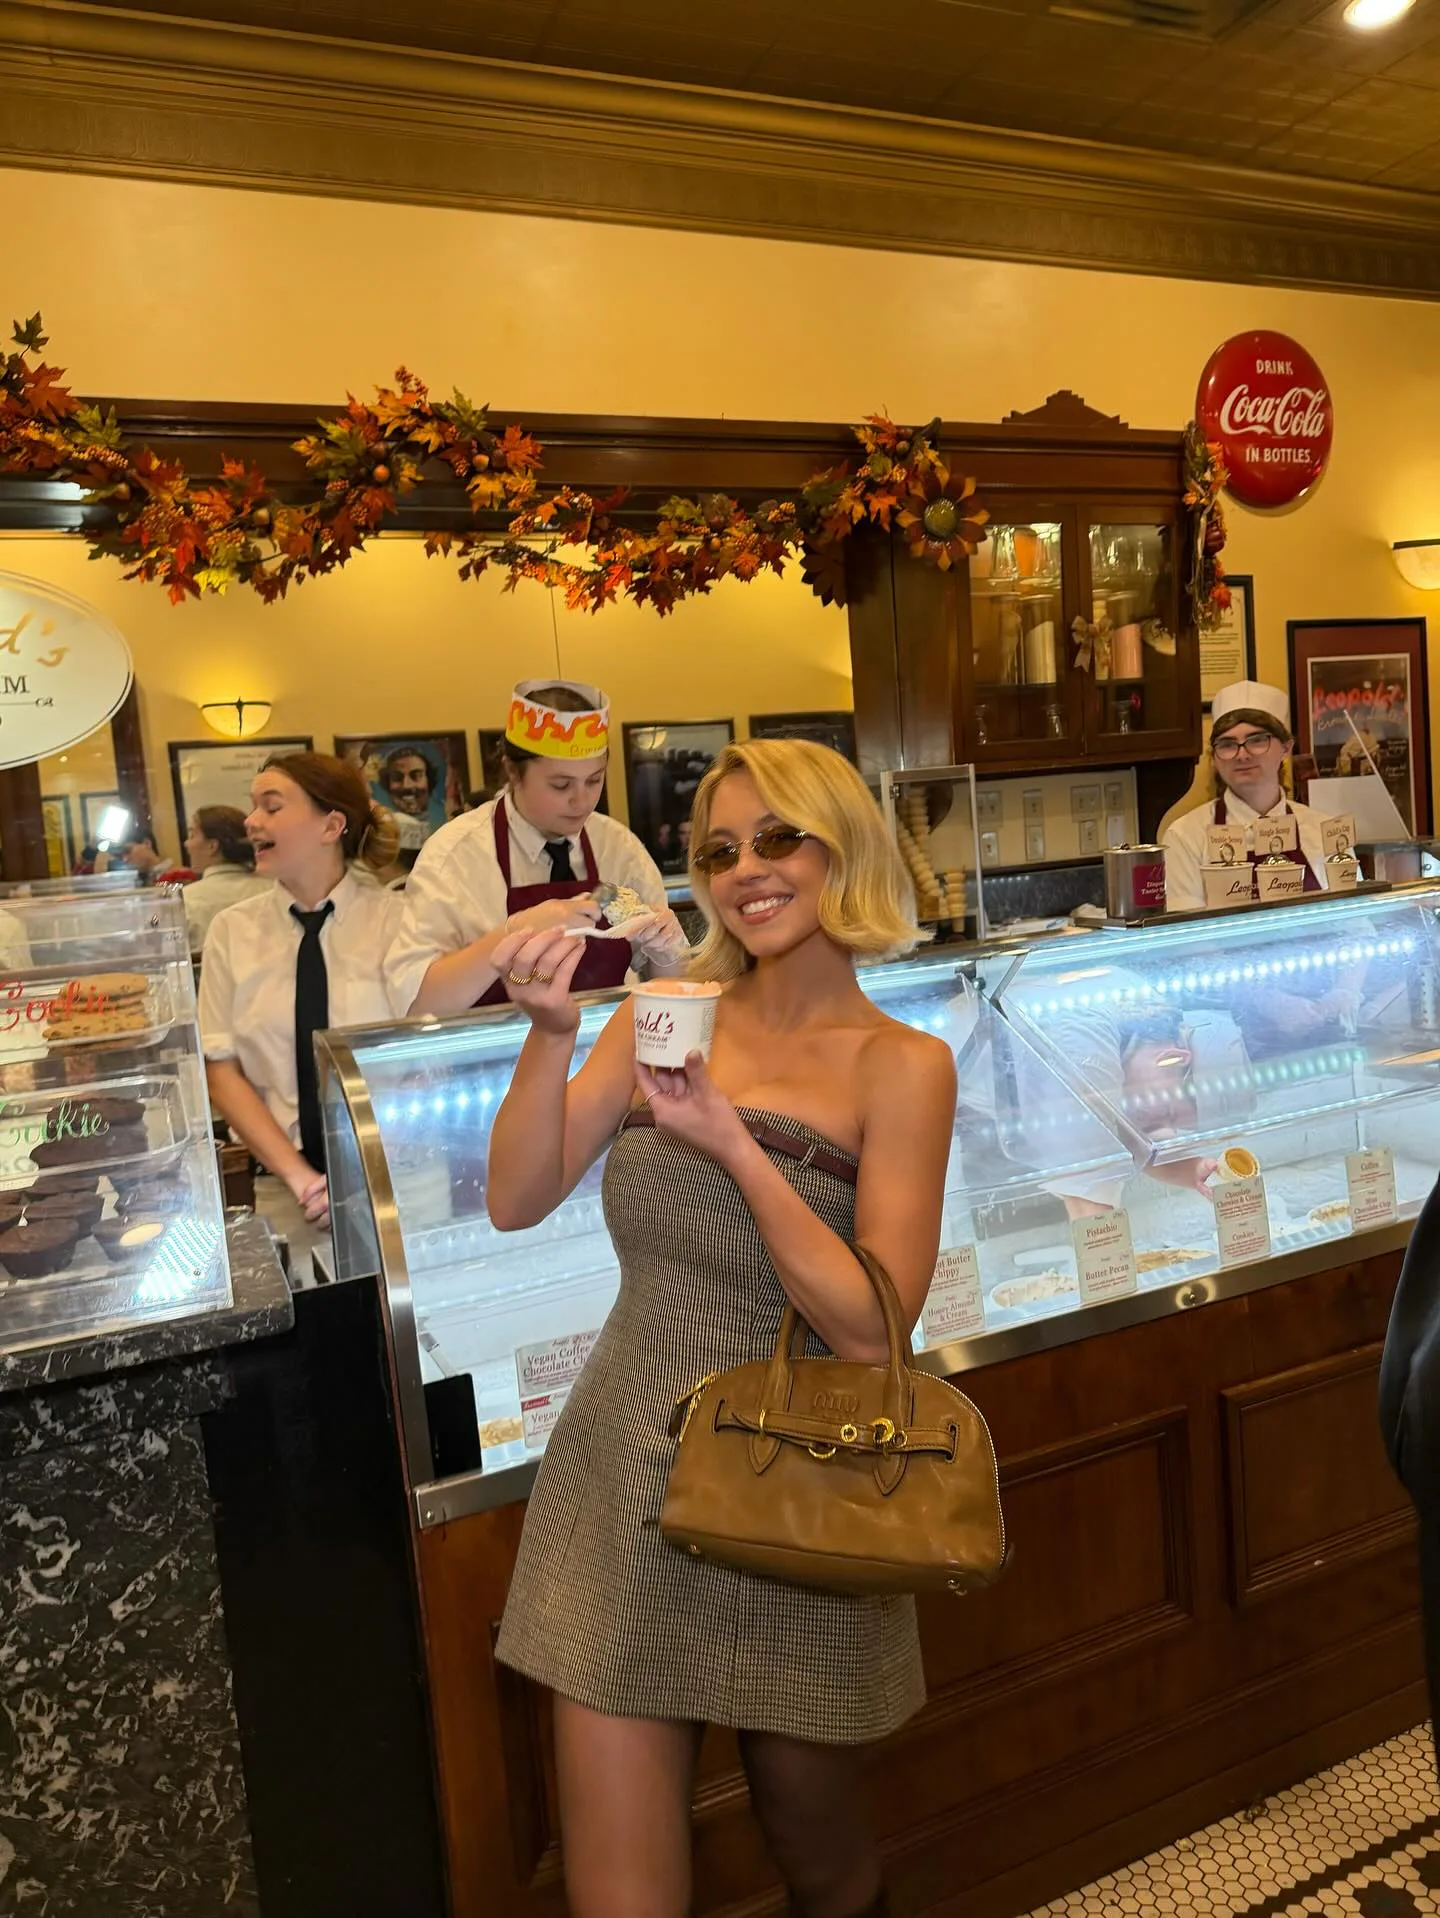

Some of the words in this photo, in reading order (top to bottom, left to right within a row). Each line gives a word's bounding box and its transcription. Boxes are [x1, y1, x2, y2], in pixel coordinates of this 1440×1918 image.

[1256, 359, 1293, 375] DRINK
[1220, 384, 1326, 438] Coca-Cola
[1246, 447, 1259, 462] IN
[1263, 447, 1311, 463] BOTTLES
[635, 1011, 675, 1034] old's
[1086, 1222, 1118, 1238] Pistachio
[947, 1255, 971, 1267] Butter
[1085, 1269, 1107, 1281] Butter
[1109, 1264, 1129, 1275] Pecan
[528, 1352, 556, 1366] Vegan
[560, 1345, 590, 1358] Coffee
[523, 1359, 571, 1378] Chocolate
